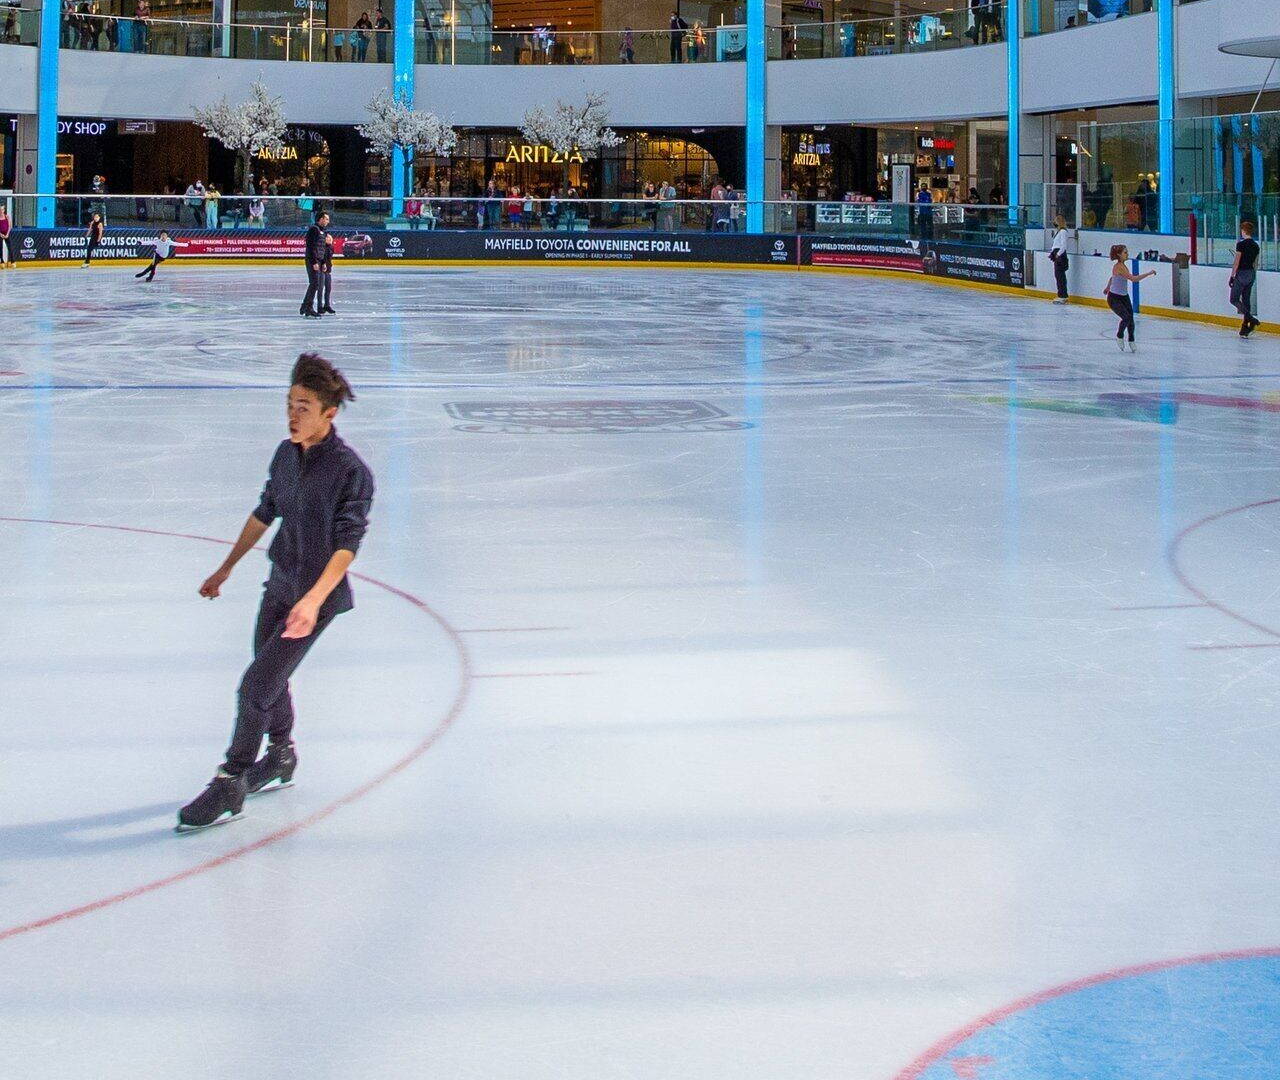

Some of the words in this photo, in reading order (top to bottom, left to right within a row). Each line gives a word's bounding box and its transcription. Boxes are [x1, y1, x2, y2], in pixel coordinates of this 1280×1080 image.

[74, 122, 107, 135] SHOP
[793, 153, 820, 166] ARITZIA
[49, 237, 86, 247] MAYFIELD
[87, 236, 116, 247] TOTA
[118, 237, 125, 246] IS
[485, 238, 533, 251] MAYFIELD
[535, 238, 574, 251] TOYOTA
[576, 238, 650, 252] CONVENIENCE
[650, 240, 670, 252] FOR
[673, 241, 691, 253] ALL
[837, 243, 856, 251] TOYOTA
[49, 248, 71, 258] WEST
[116, 248, 138, 257] MALL
